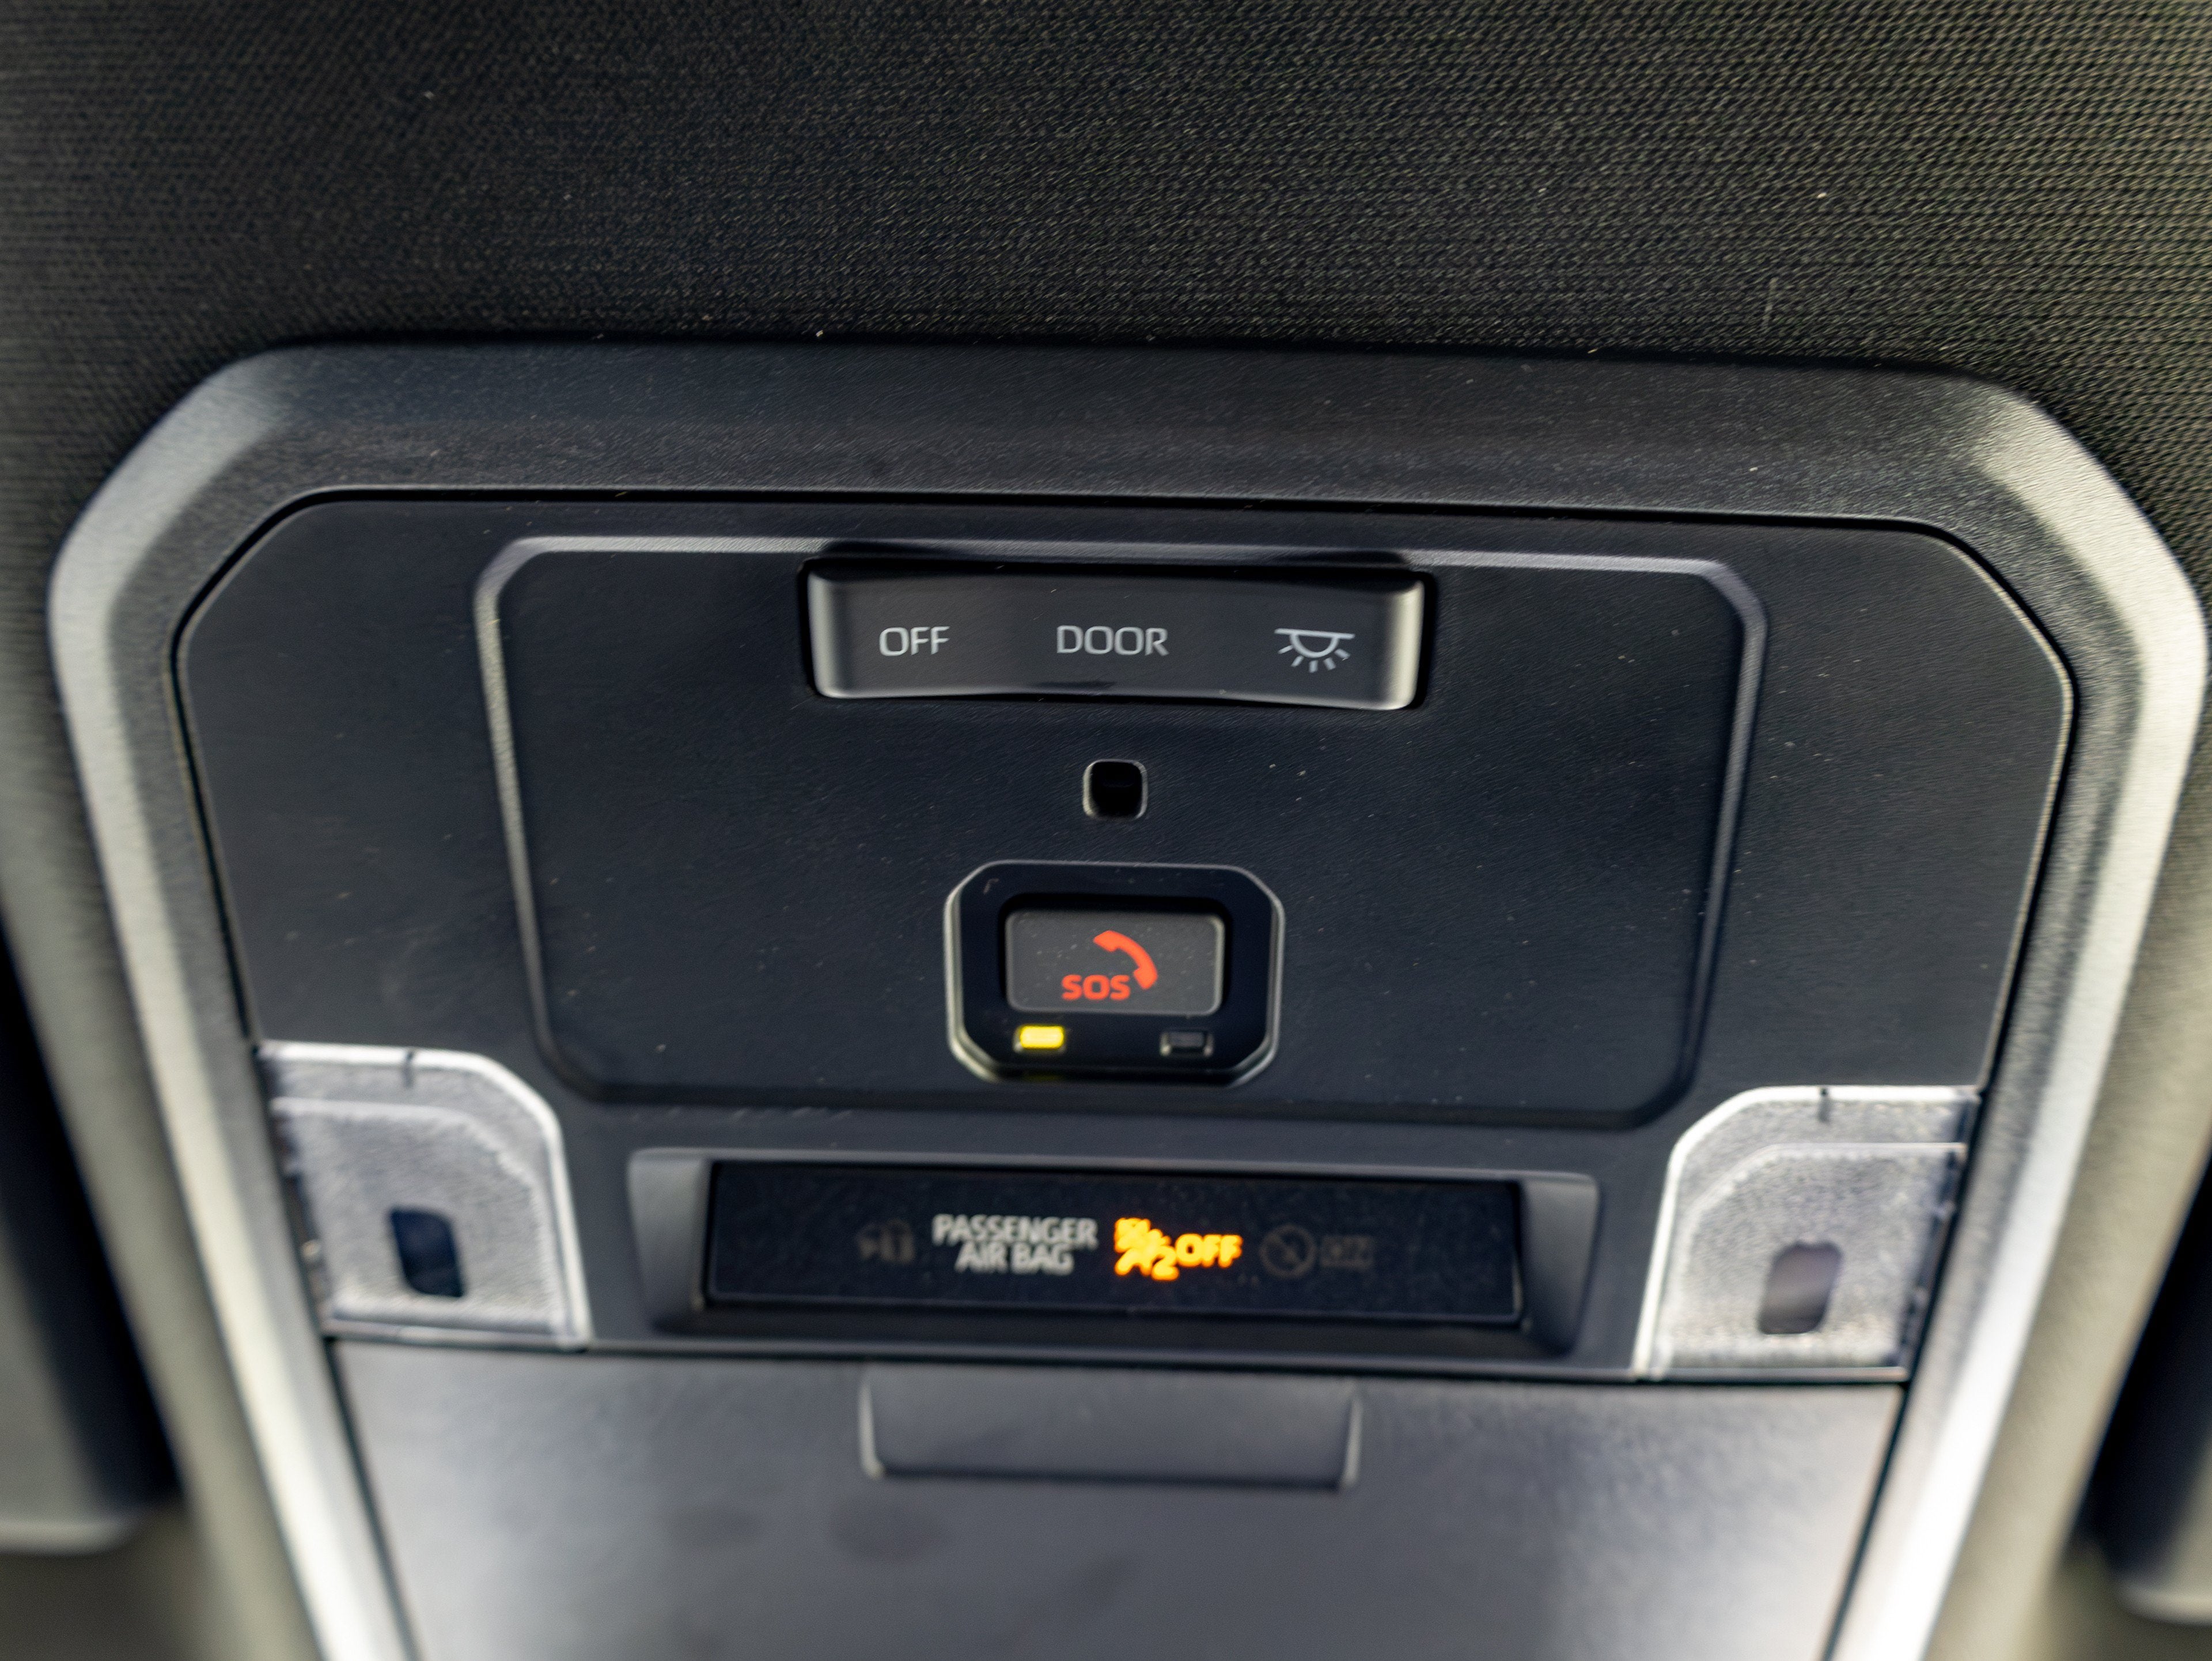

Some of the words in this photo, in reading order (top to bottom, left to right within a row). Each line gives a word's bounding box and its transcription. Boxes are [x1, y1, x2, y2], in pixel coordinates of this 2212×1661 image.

[879, 626, 950, 656] OFF
[1056, 625, 1169, 656] DOOR
[1061, 974, 1131, 1000] SOS
[932, 1213, 1099, 1250] PASSENGER
[955, 1242, 1008, 1273] AIR
[1011, 1243, 1074, 1275] BAG
[1176, 1234, 1242, 1267] OFF
